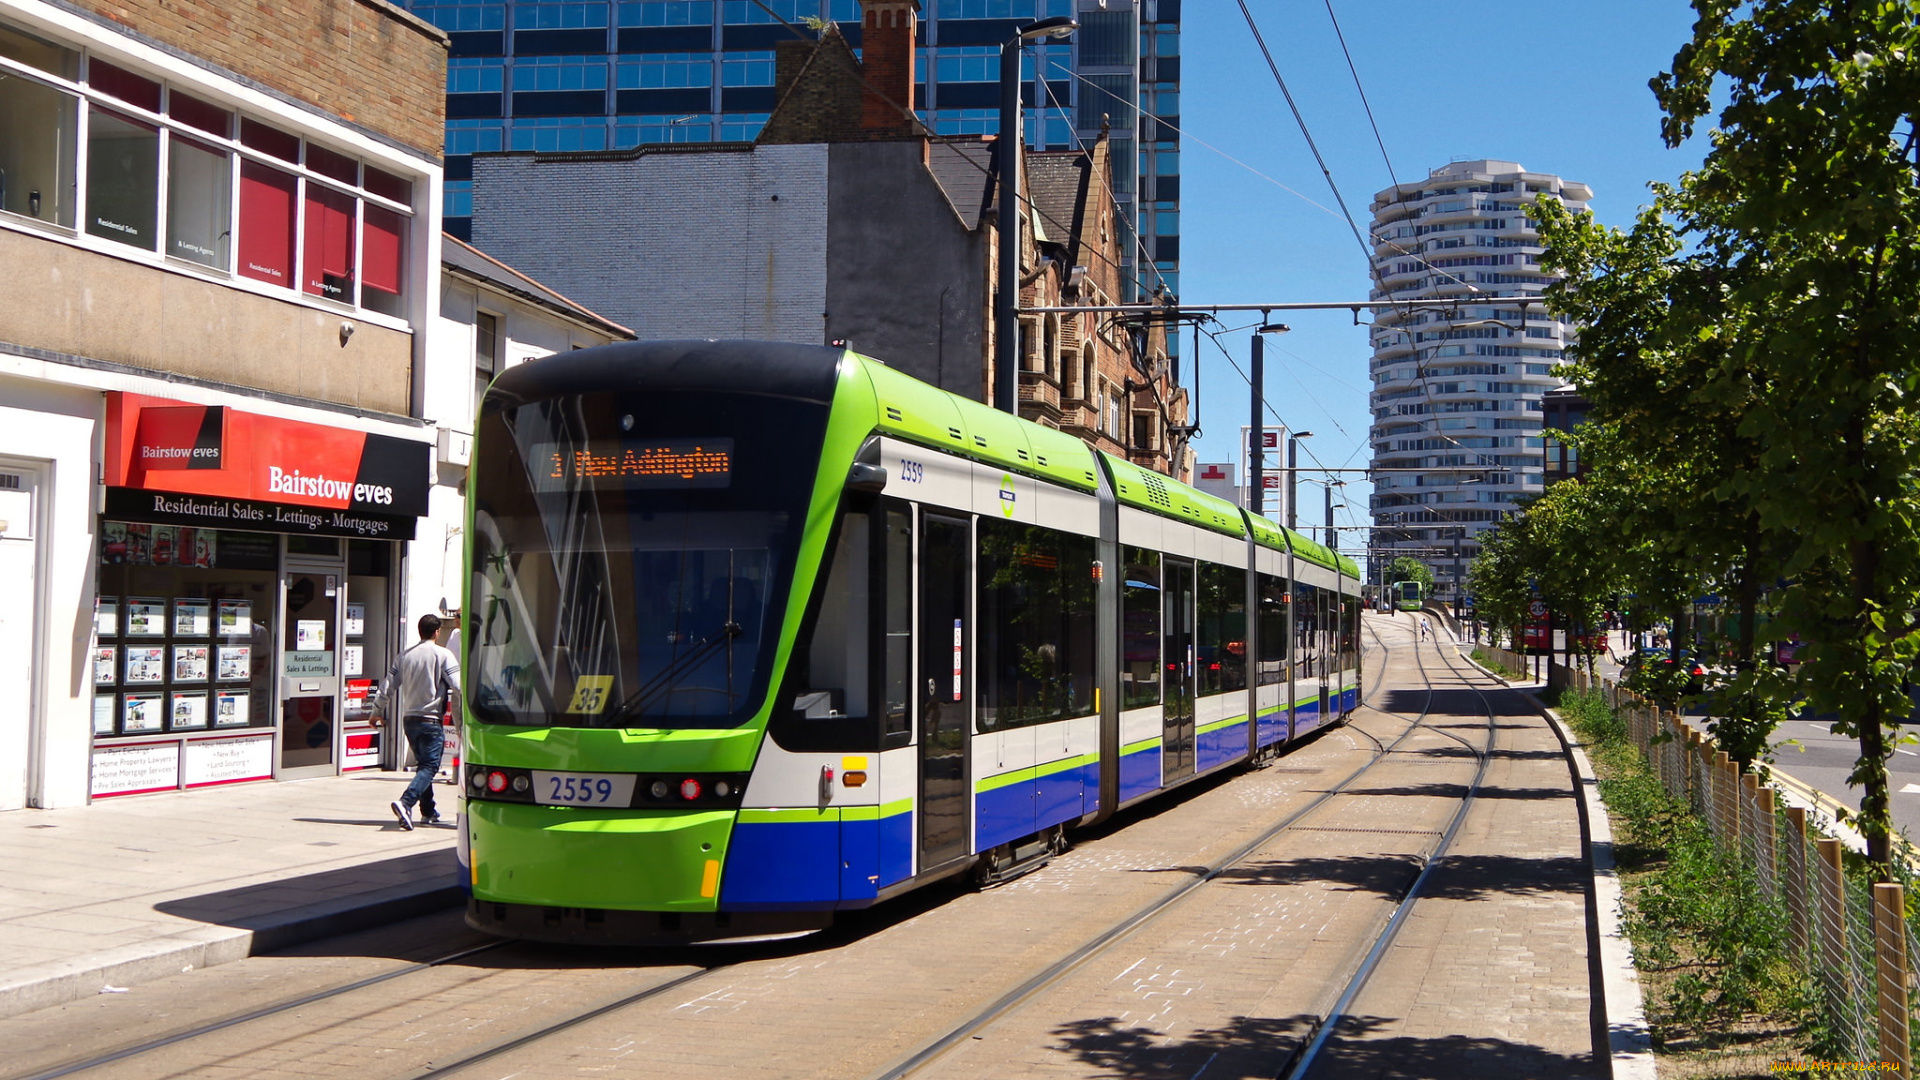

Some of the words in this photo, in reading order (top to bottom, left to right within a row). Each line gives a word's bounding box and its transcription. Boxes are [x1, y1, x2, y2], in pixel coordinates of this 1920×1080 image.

[98, 217, 125, 231] Residential
[125, 225, 138, 235] Sales
[249, 262, 271, 274] Residential
[271, 268, 282, 277] Sales
[142, 446, 192, 458] Bairstow
[193, 447, 219, 458] eves
[576, 451, 617, 476] New
[621, 446, 729, 478] Addington
[901, 459, 923, 484] 2559
[269, 466, 353, 500] Bairstow
[354, 483, 393, 505] eves
[154, 495, 229, 518] Residential
[232, 504, 264, 521] Sales
[275, 507, 322, 529] Lettings
[332, 512, 389, 535] Mortgages
[1532, 604, 1544, 613] 20
[287, 665, 300, 673] Sales
[308, 665, 329, 674] Lettings
[575, 687, 604, 711] 35
[120, 758, 146, 767] Property
[148, 756, 171, 765] Lawyers
[99, 770, 118, 778] Home
[120, 769, 147, 778] Mortgage
[149, 766, 172, 774] Services
[111, 780, 125, 788] Sales
[550, 776, 612, 802] 2559
